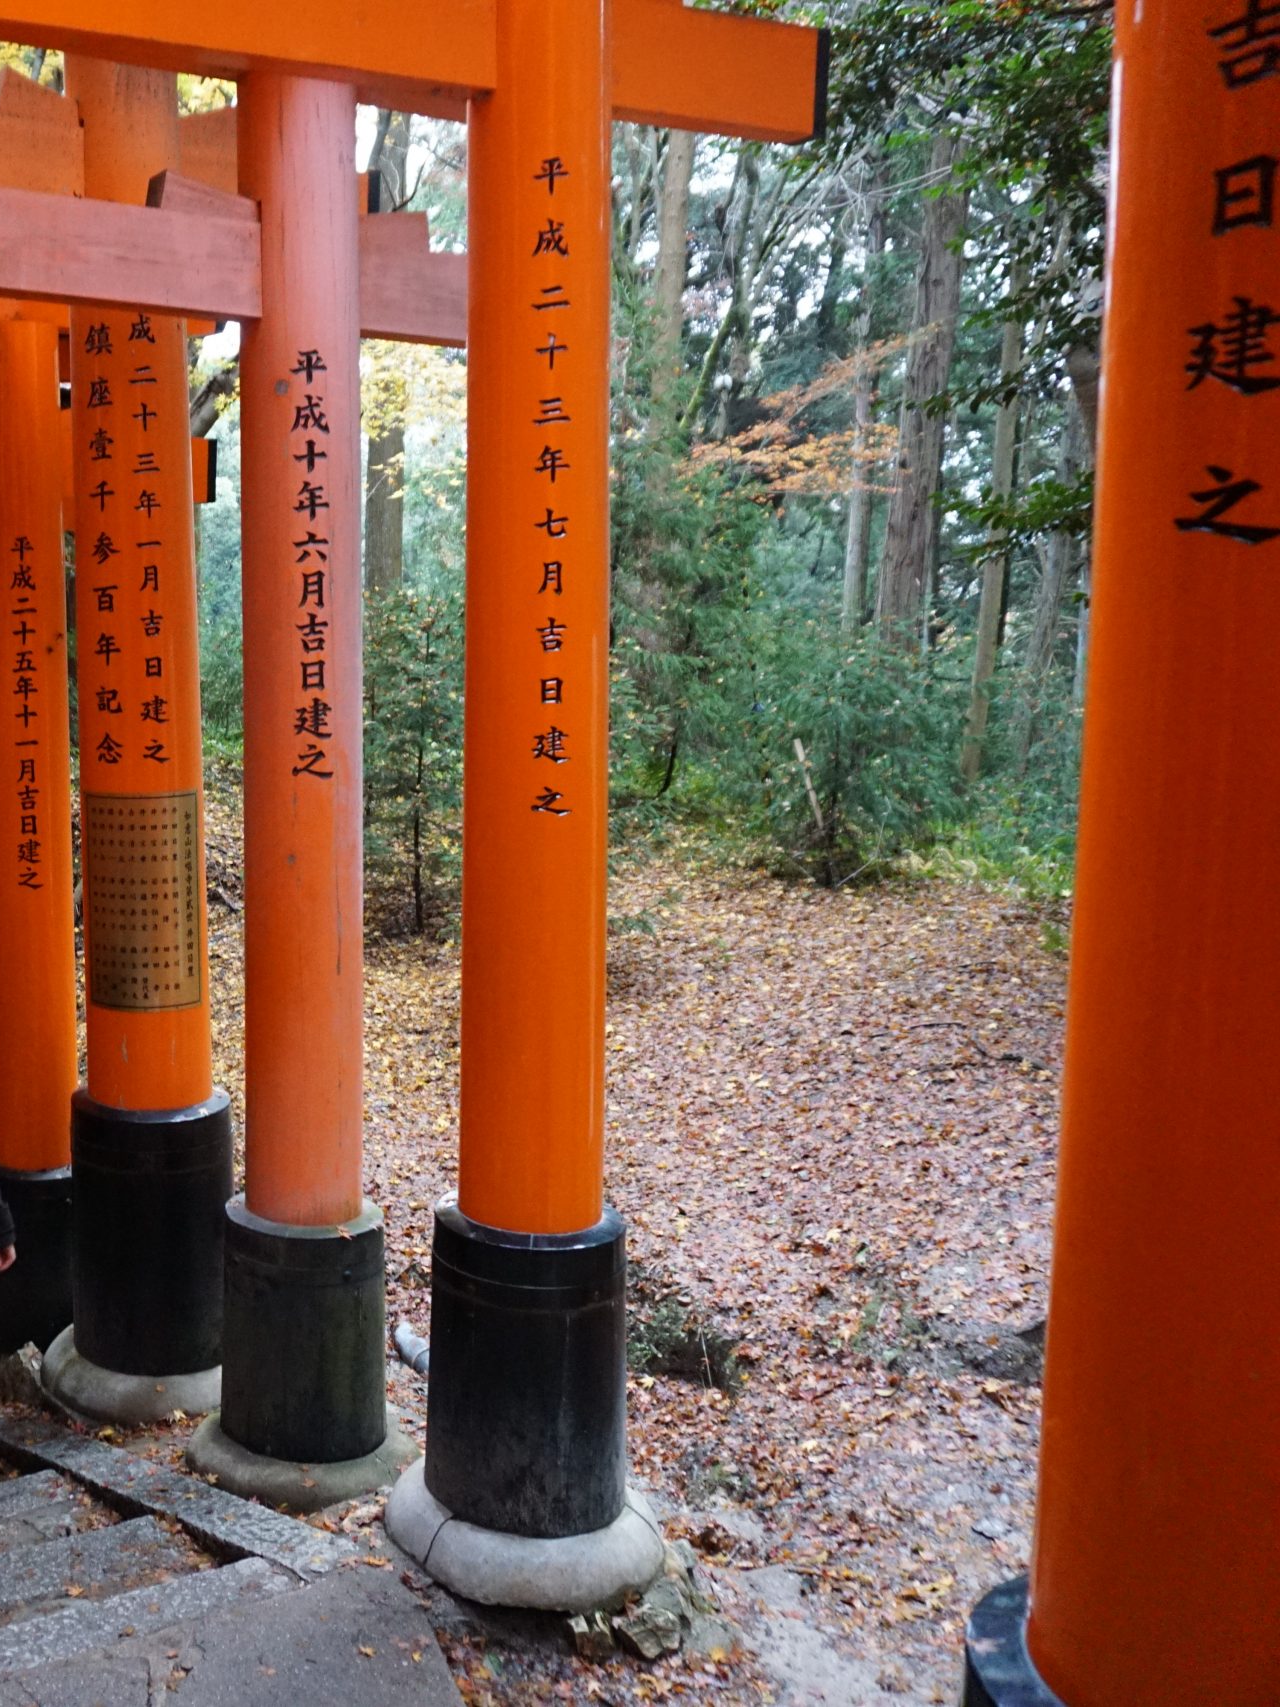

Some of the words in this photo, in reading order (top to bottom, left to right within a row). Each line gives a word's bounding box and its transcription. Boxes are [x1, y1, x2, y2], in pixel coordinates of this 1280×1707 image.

[128, 313, 172, 766] 成二十三年一月吉日建之
[290, 349, 334, 779] 平成十年六月吉日建之
[531, 156, 573, 816] 平成二十三年七月吉日建之
[11, 536, 44, 890] 平成二十五年十一月吉日建之
